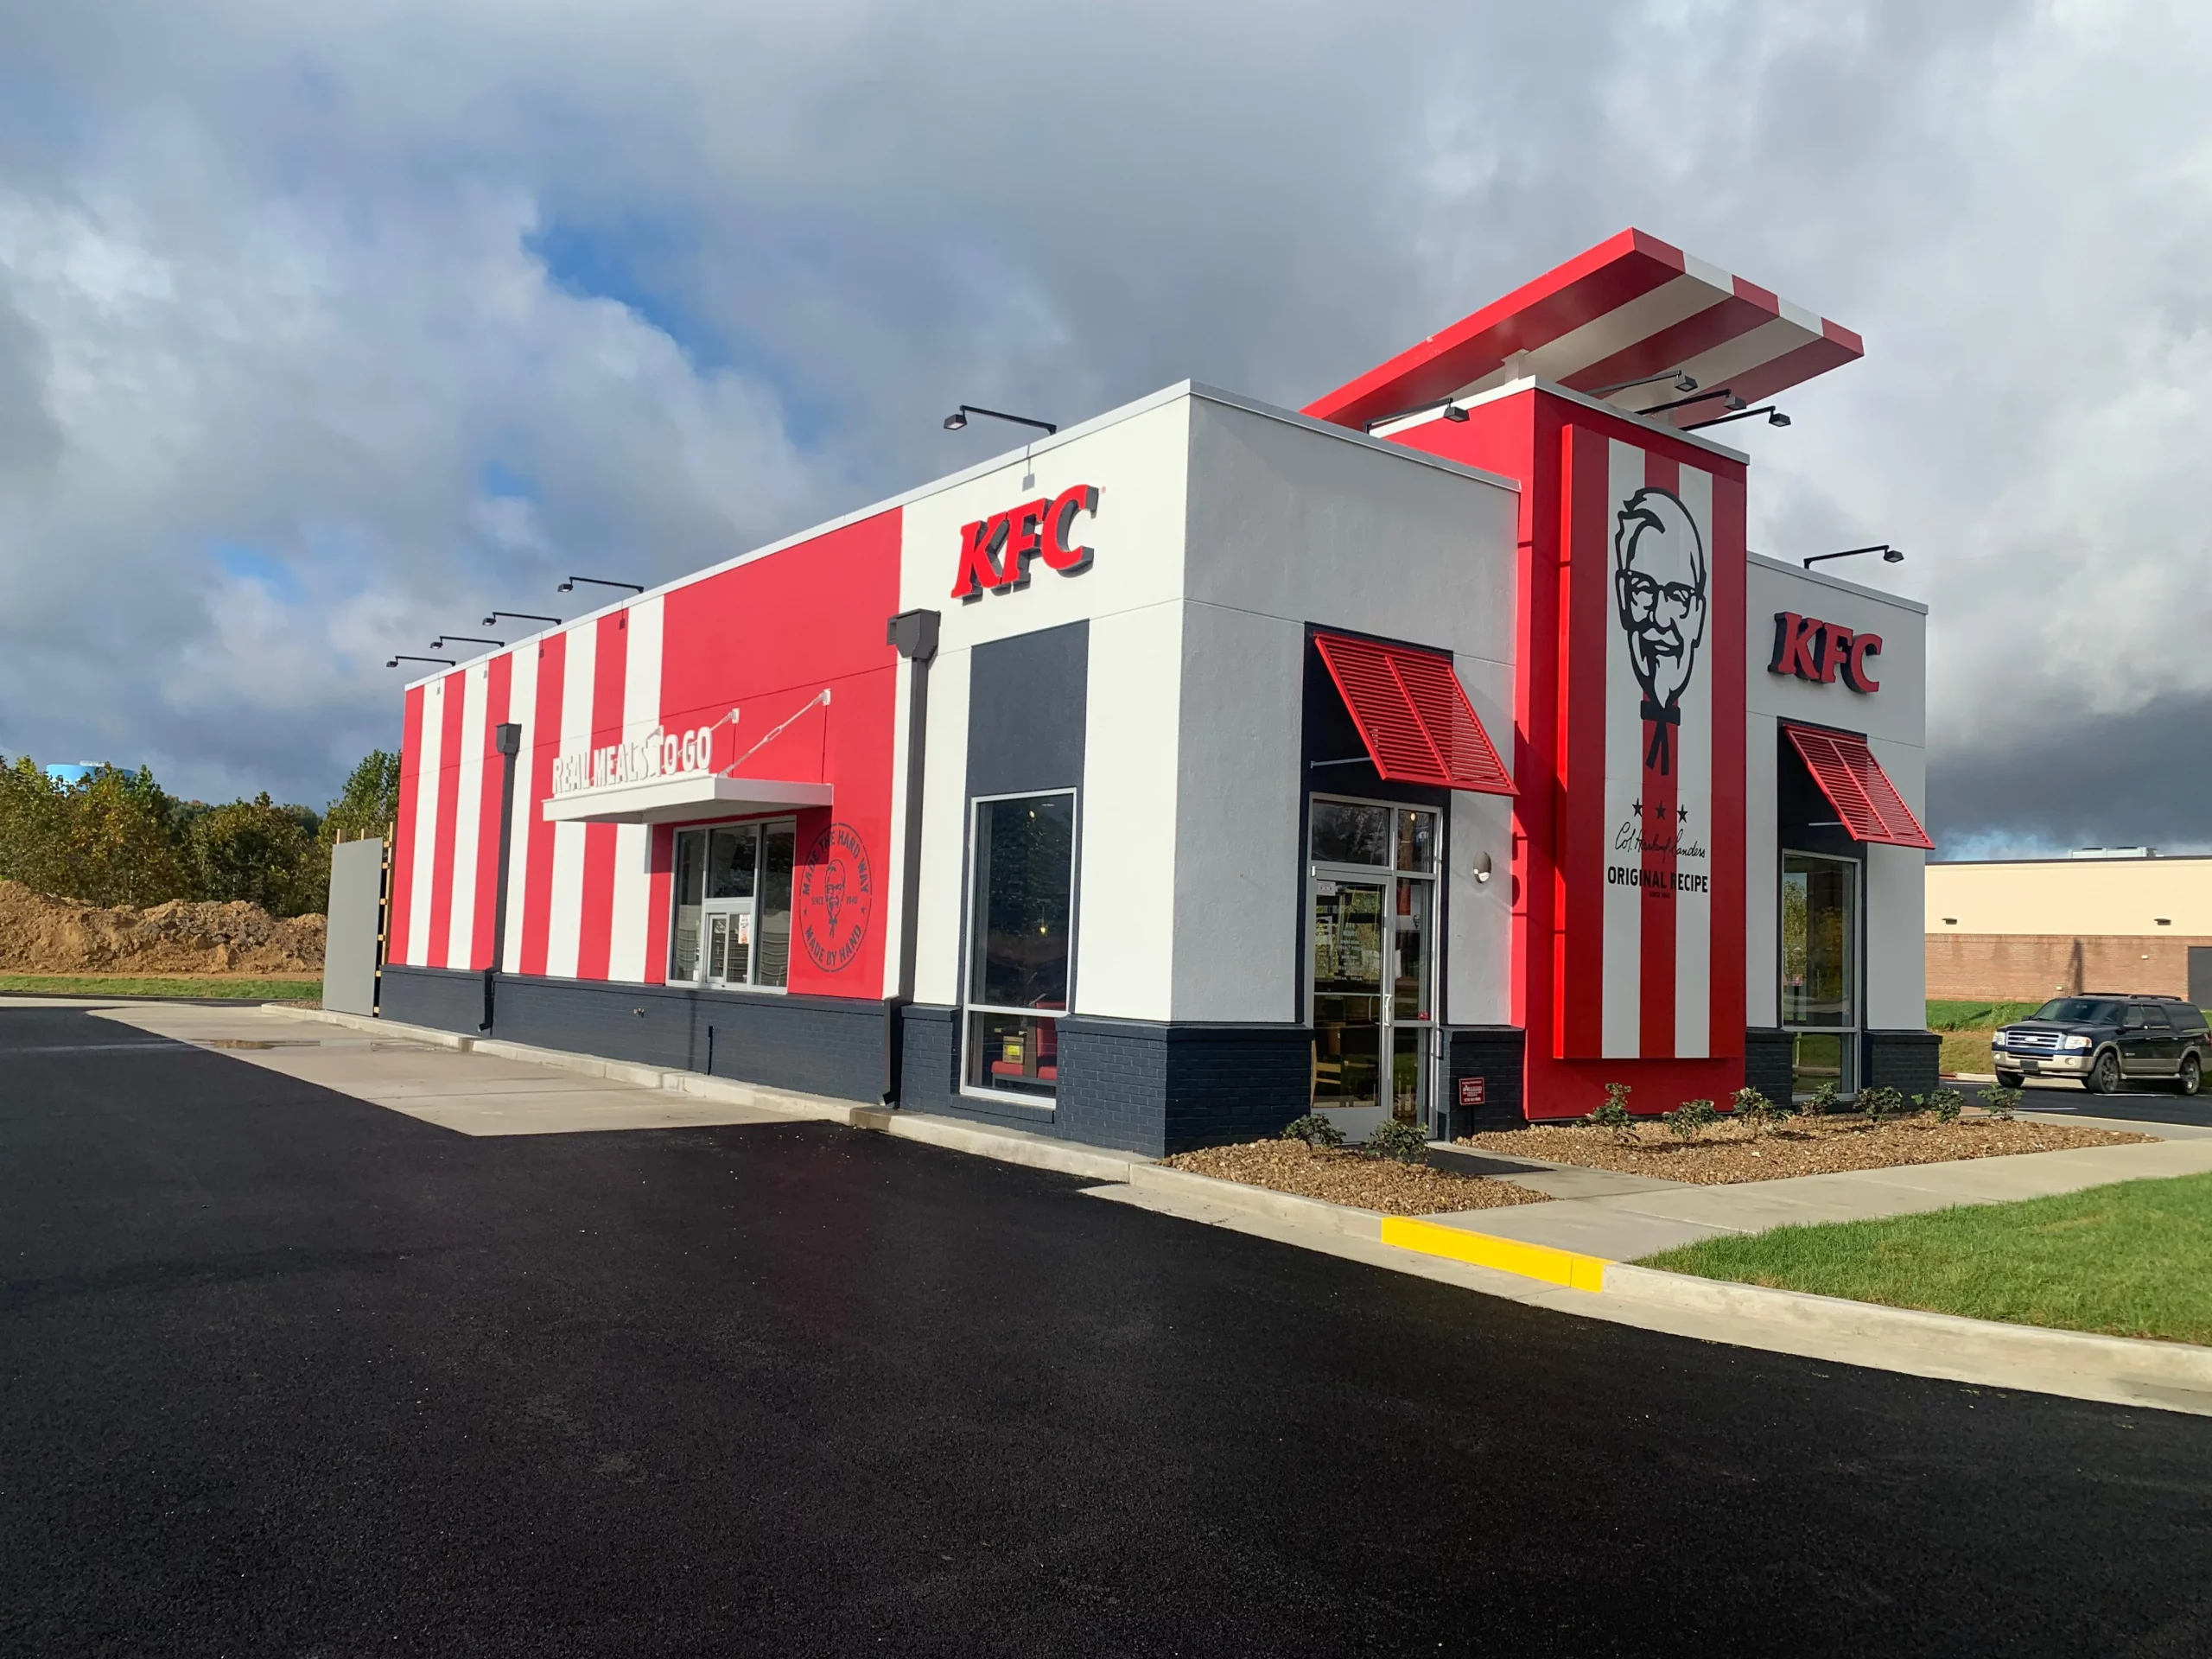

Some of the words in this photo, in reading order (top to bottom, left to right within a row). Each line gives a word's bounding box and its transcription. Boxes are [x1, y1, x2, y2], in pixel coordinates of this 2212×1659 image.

[951, 485, 1098, 605] KFC
[1768, 611, 1883, 693] KFC
[552, 752, 591, 794] REAL
[593, 741, 649, 789] MEALS
[647, 732, 678, 778] TO
[682, 726, 712, 772] GO
[803, 851, 819, 895] MADE
[818, 830, 836, 851] THE
[838, 830, 861, 859] HARD
[858, 857, 869, 893] WAY
[1607, 866, 1667, 889] ORIGINAL
[1670, 872, 1708, 893] RECIPE
[805, 925, 823, 962] MADE
[826, 951, 836, 966] BY
[840, 925, 861, 963] HAND
